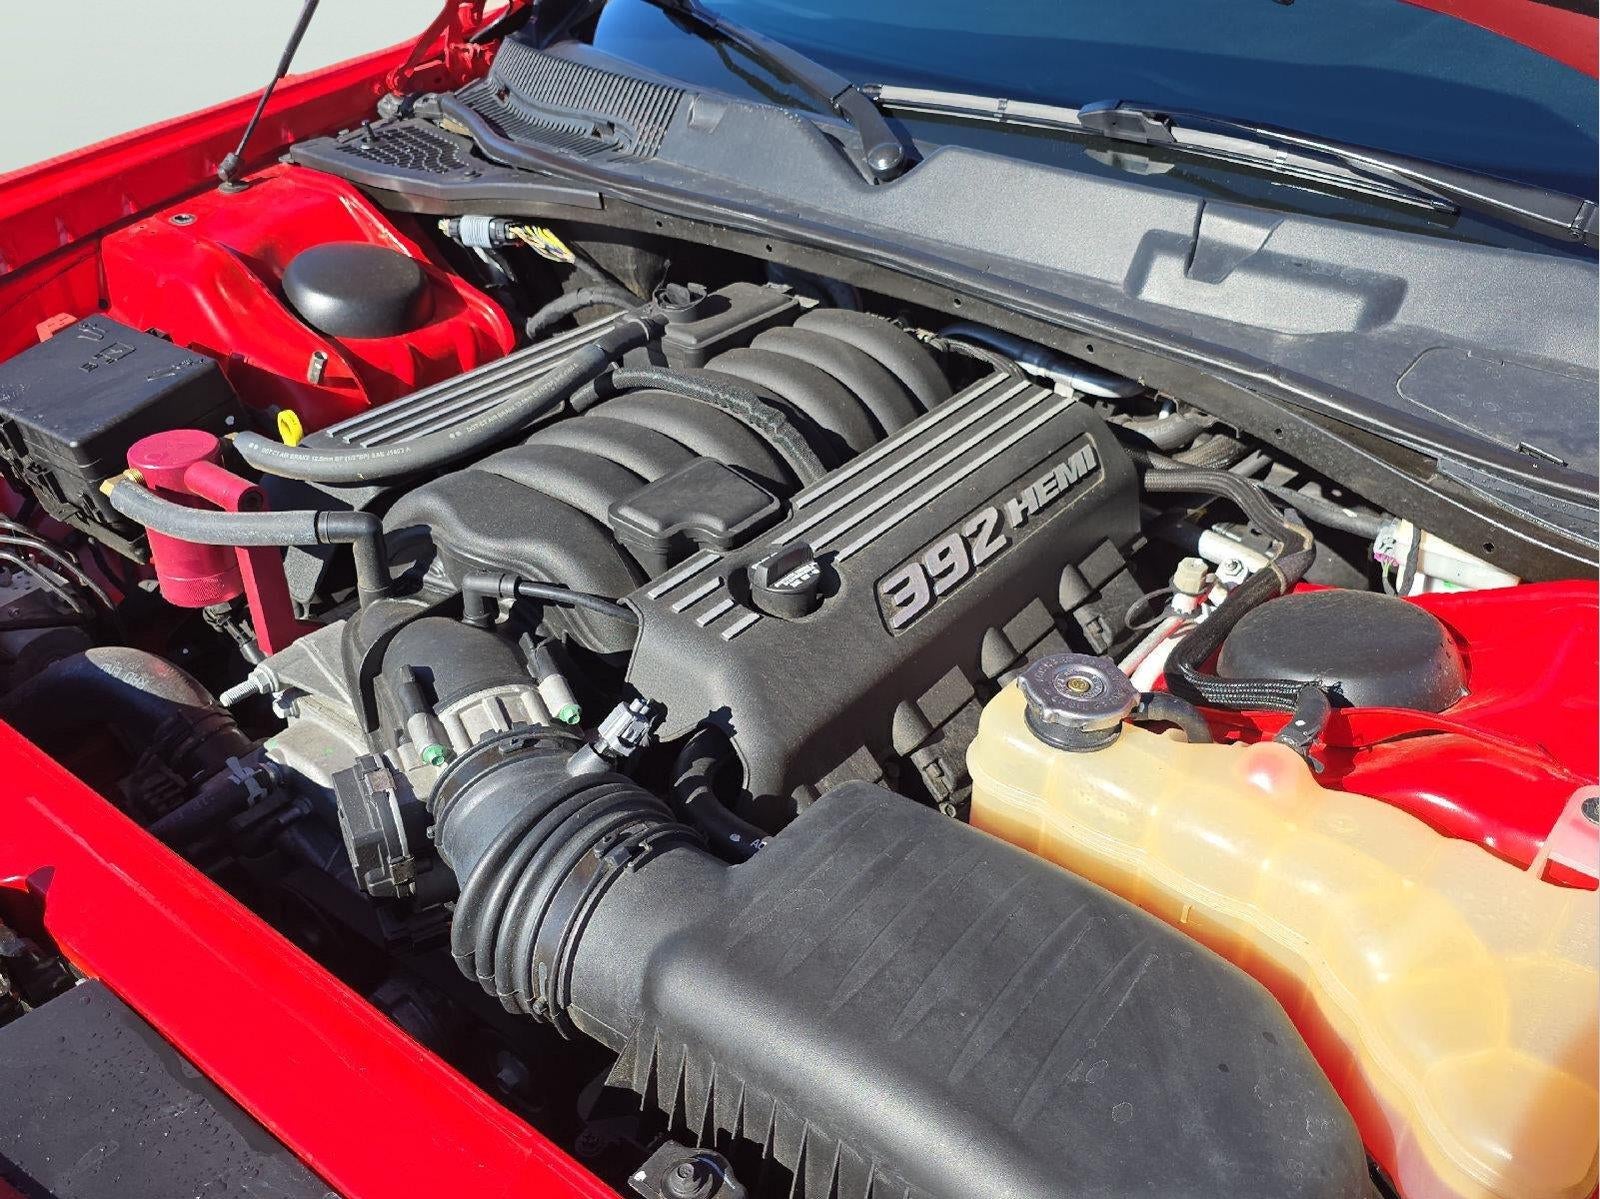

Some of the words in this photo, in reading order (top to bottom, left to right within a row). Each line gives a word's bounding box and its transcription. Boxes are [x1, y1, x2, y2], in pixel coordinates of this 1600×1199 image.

[261, 447, 273, 455] DOT
[289, 453, 311, 461] BRAKE
[881, 506, 1007, 629] 392
[1006, 443, 1097, 528] HEMI
